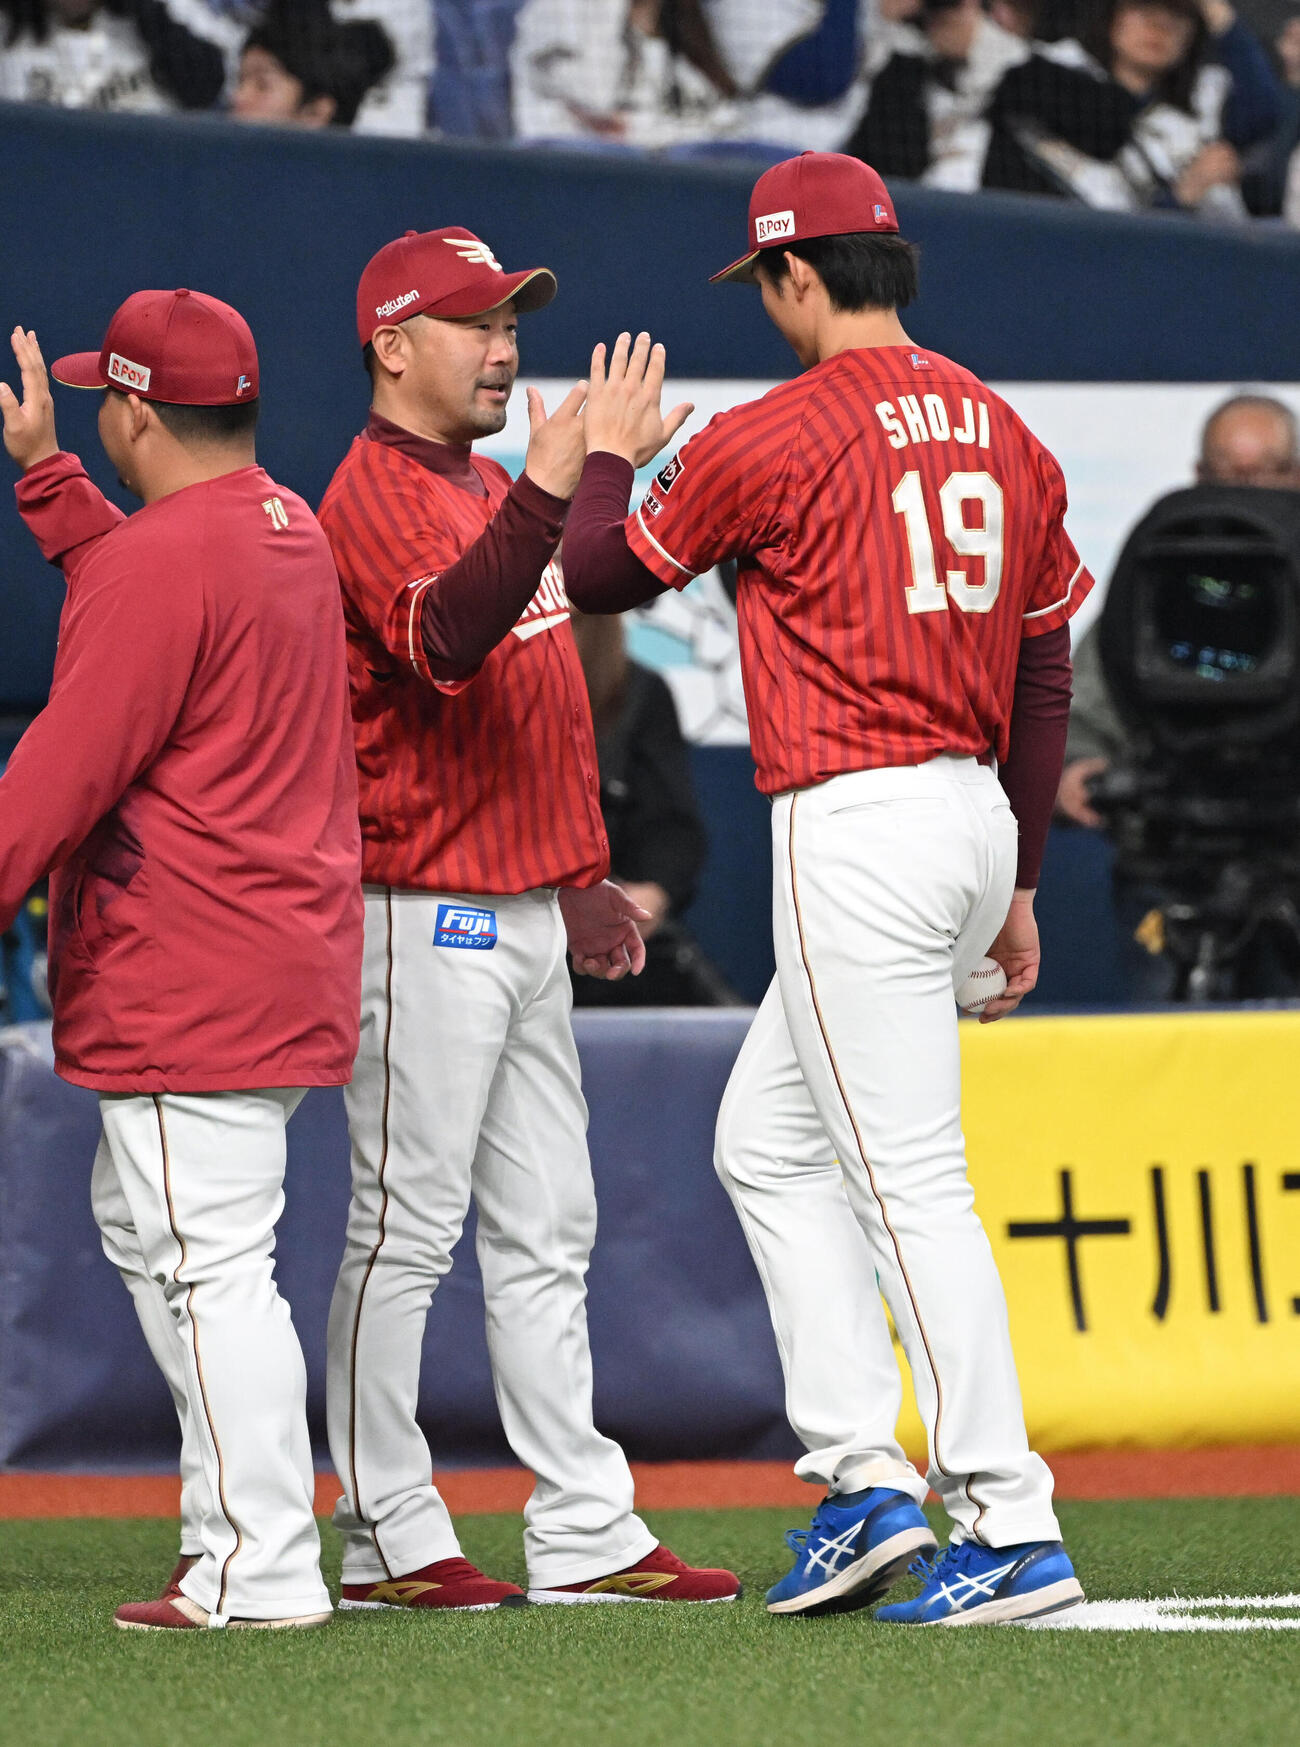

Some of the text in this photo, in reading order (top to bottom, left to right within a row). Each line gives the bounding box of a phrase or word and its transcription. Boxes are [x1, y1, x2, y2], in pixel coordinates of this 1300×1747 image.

[375, 289, 420, 319] Rakuten
[875, 393, 990, 450] SHOJI
[261, 497, 288, 530] 70
[891, 470, 1005, 614] 19
[441, 909, 491, 935] Fuji
[440, 934, 490, 946] タイヤはフジ
[1006, 1162, 1300, 1333] 十川
